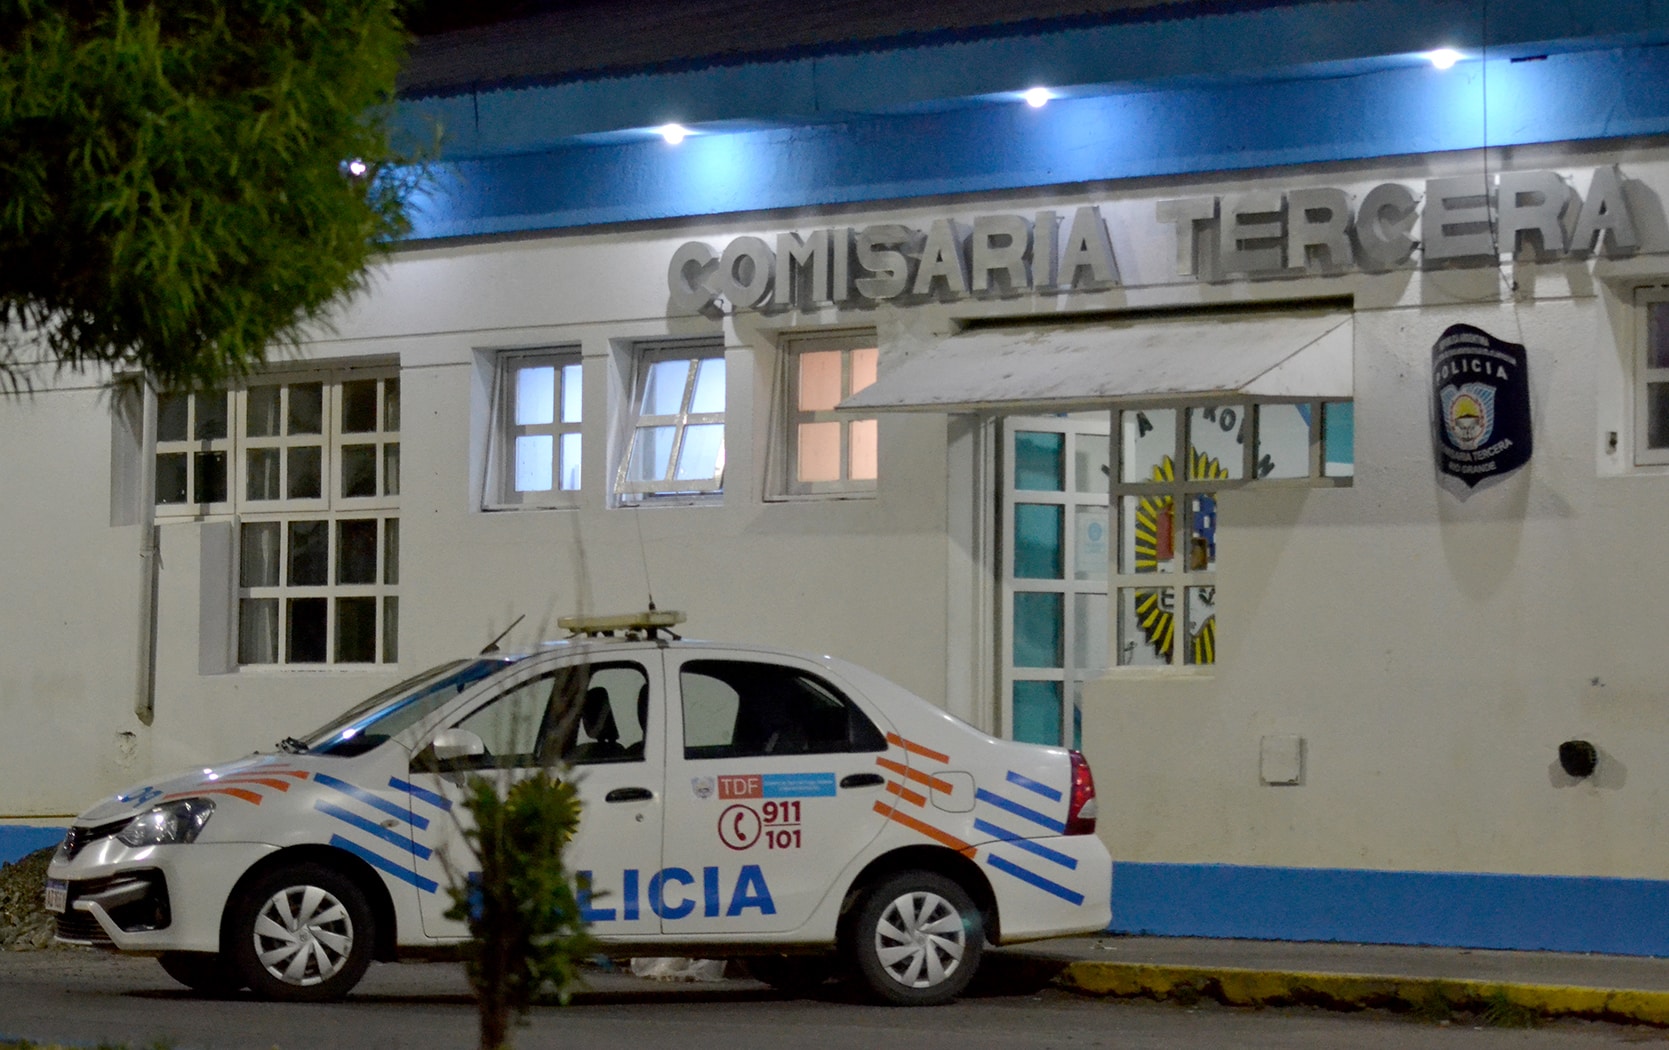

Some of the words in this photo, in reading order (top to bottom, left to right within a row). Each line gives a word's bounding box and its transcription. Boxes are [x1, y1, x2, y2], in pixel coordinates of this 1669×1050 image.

[667, 205, 1119, 309] COMISARIA
[1156, 164, 1642, 280] TERCERA
[720, 778, 759, 796] TDF
[762, 800, 801, 824] 911
[765, 829, 801, 849] 101
[468, 864, 777, 922] LICIA
